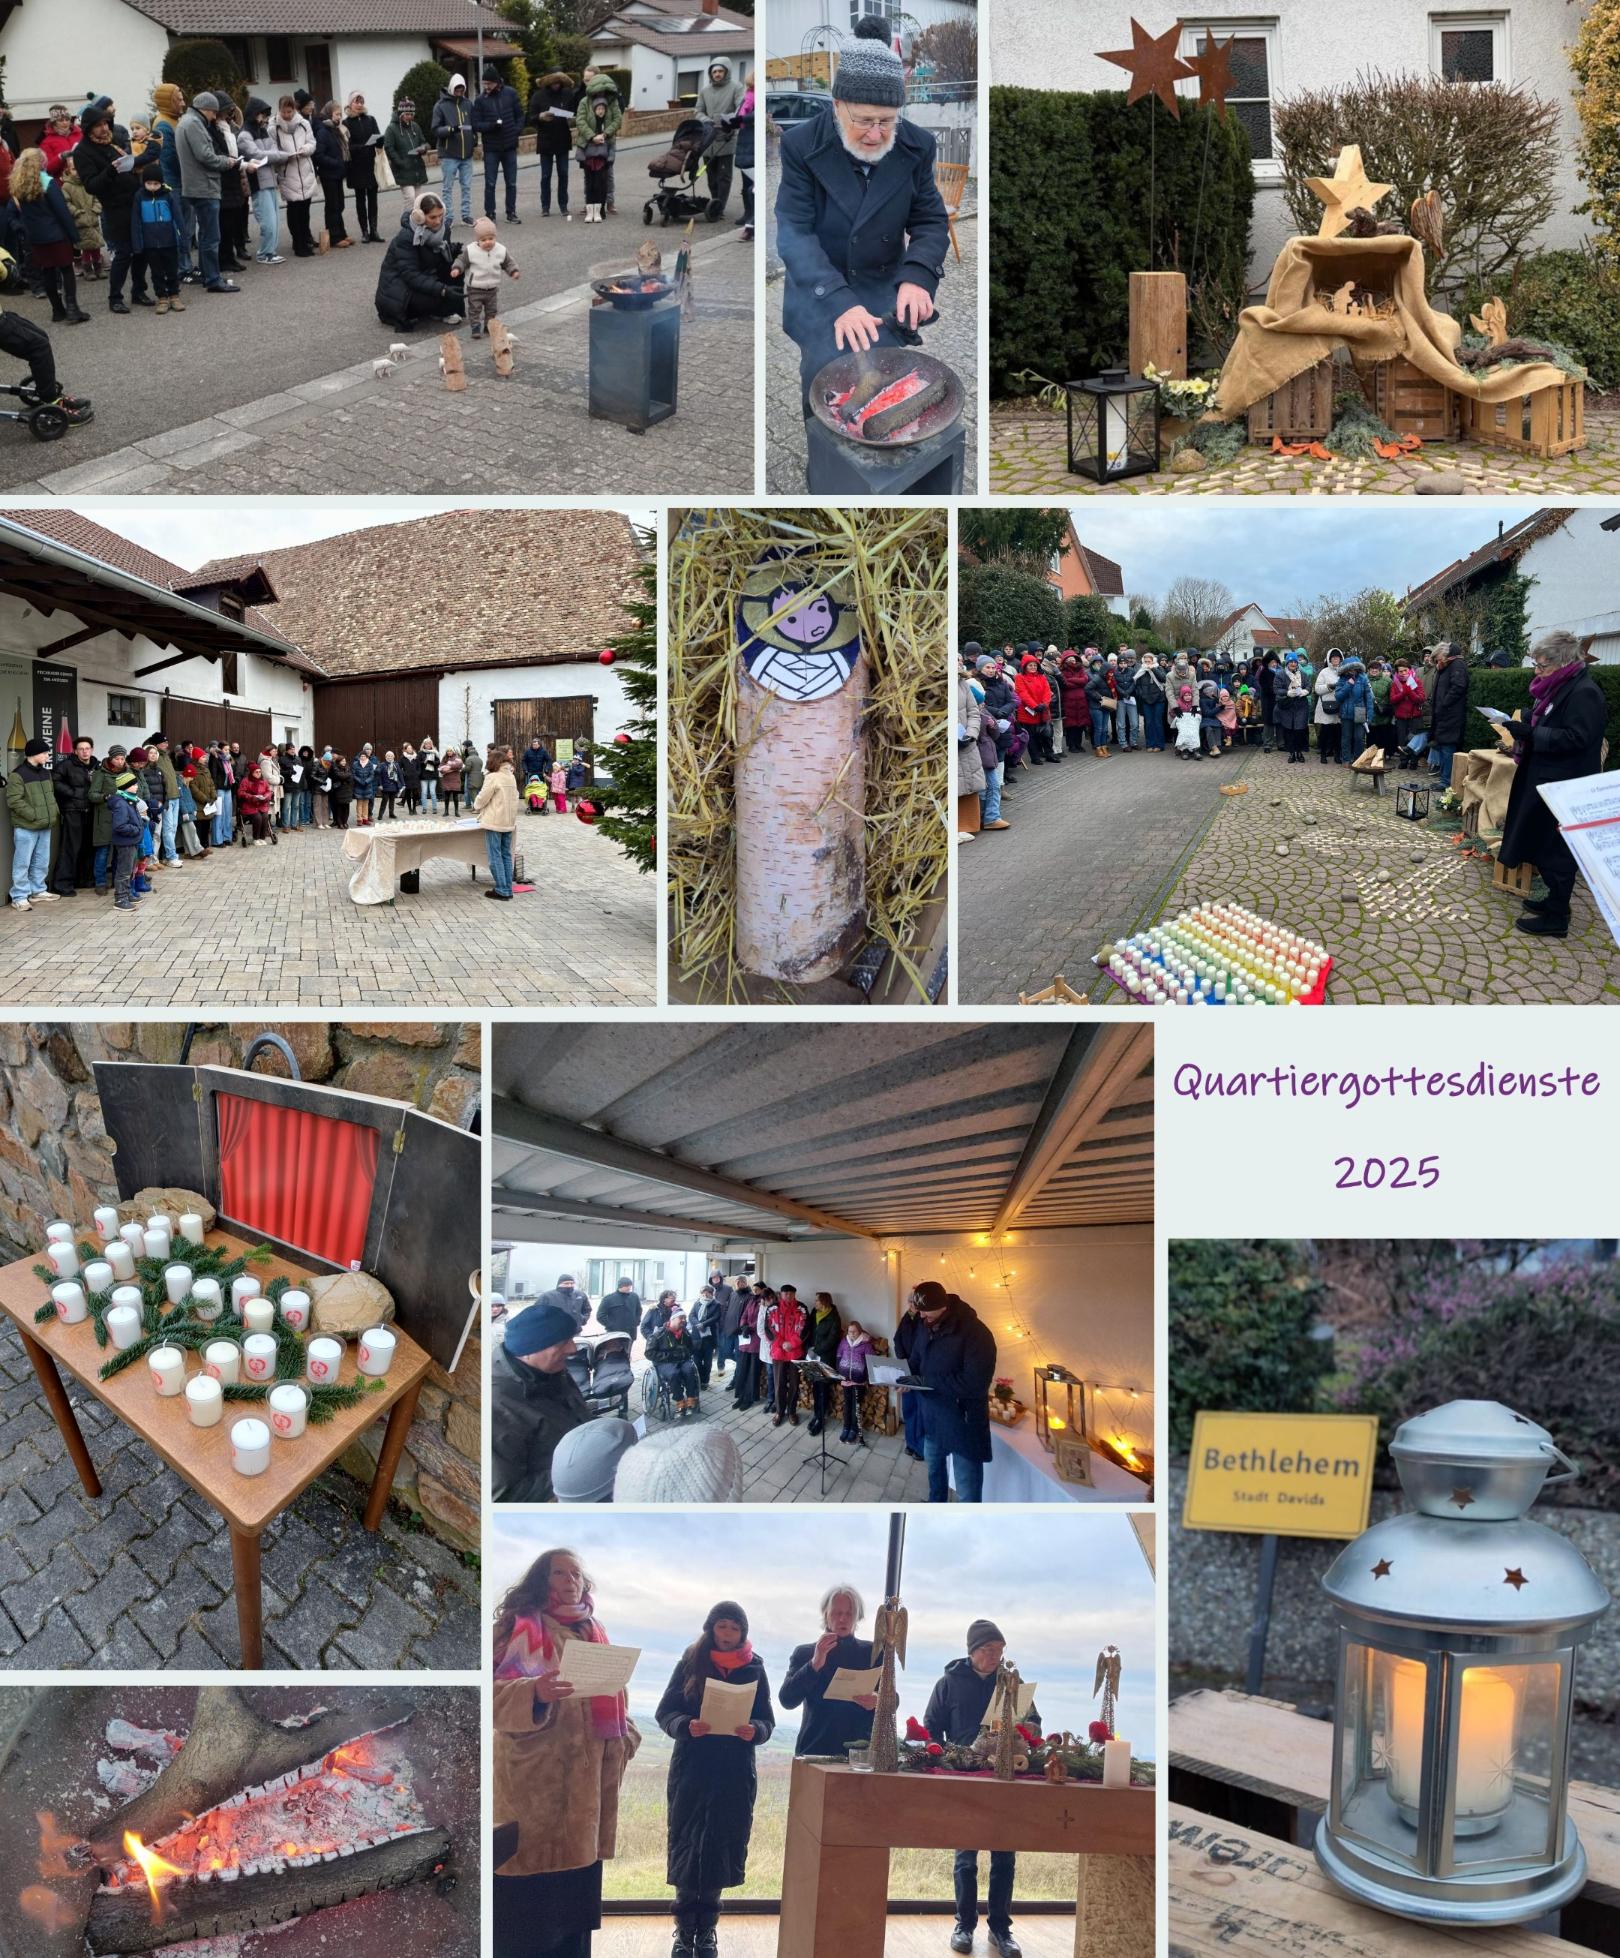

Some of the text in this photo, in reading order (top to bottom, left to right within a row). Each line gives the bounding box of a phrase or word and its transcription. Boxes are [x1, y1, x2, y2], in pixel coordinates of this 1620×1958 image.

[1204, 1448, 1360, 1477] Bethlehem
[1233, 1491, 1325, 1505] Stadt Davids
